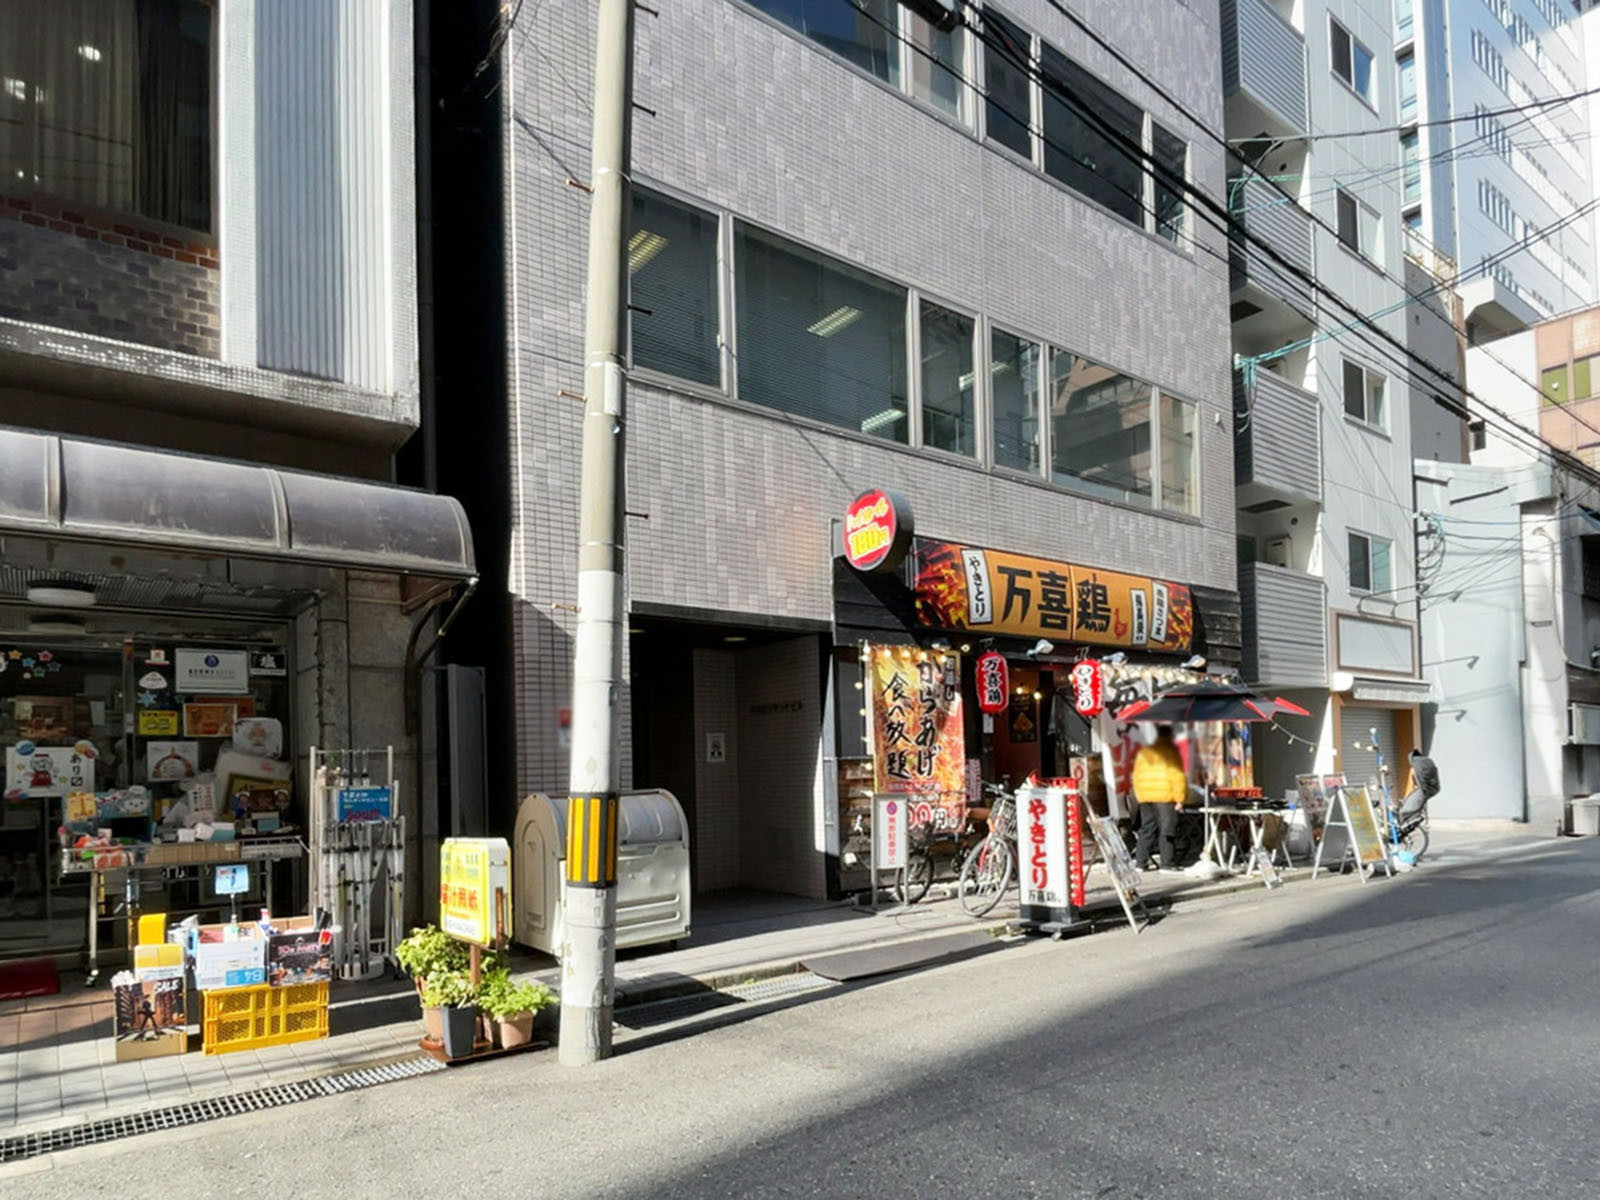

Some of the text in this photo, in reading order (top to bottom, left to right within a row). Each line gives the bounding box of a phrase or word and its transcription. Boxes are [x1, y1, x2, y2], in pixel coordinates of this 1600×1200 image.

[969, 556, 985, 617] やきとり
[997, 566, 1111, 633] 万喜鶏
[882, 672, 914, 778] 食べ放題
[1028, 799, 1047, 889] やきとり
